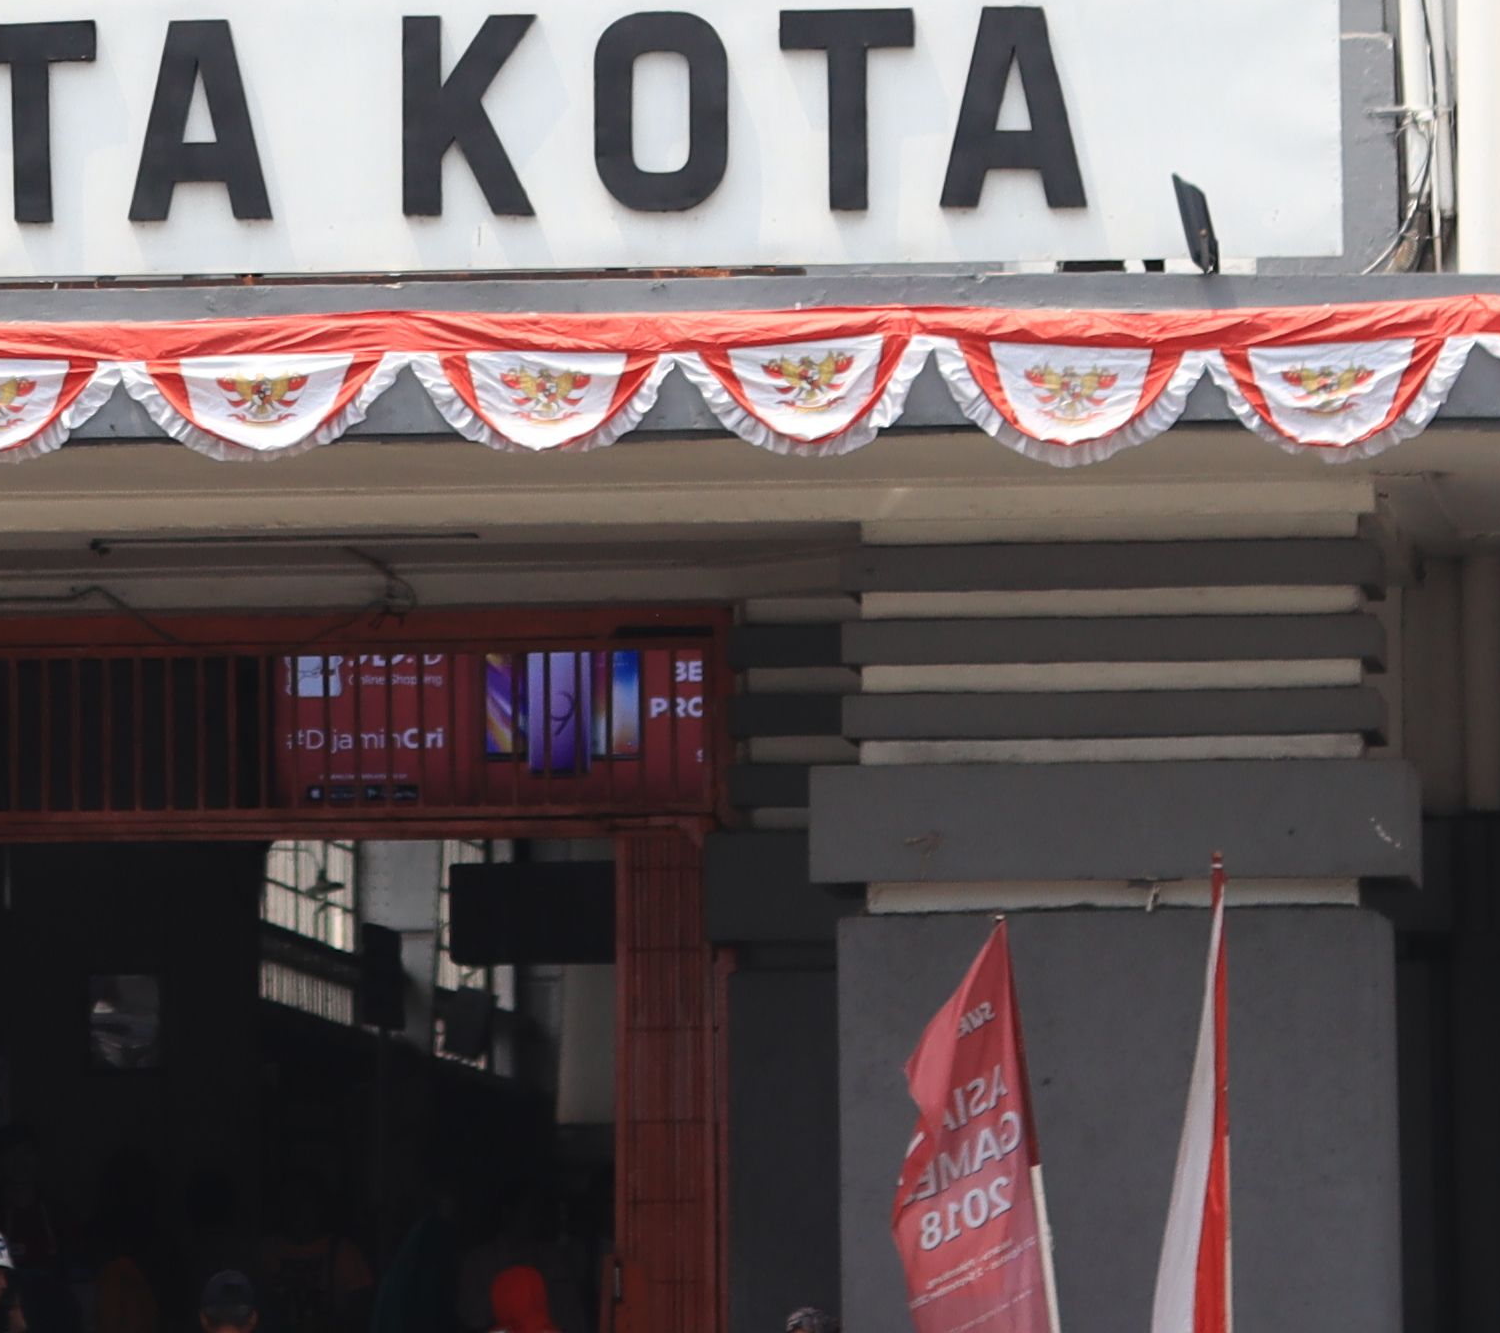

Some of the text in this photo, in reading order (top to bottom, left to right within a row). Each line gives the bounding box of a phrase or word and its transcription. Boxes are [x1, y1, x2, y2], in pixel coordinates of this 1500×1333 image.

[402, 5, 1088, 217] KOTA
[391, 674, 443, 688] Shoping
[286, 727, 443, 754] #DjaminOri
